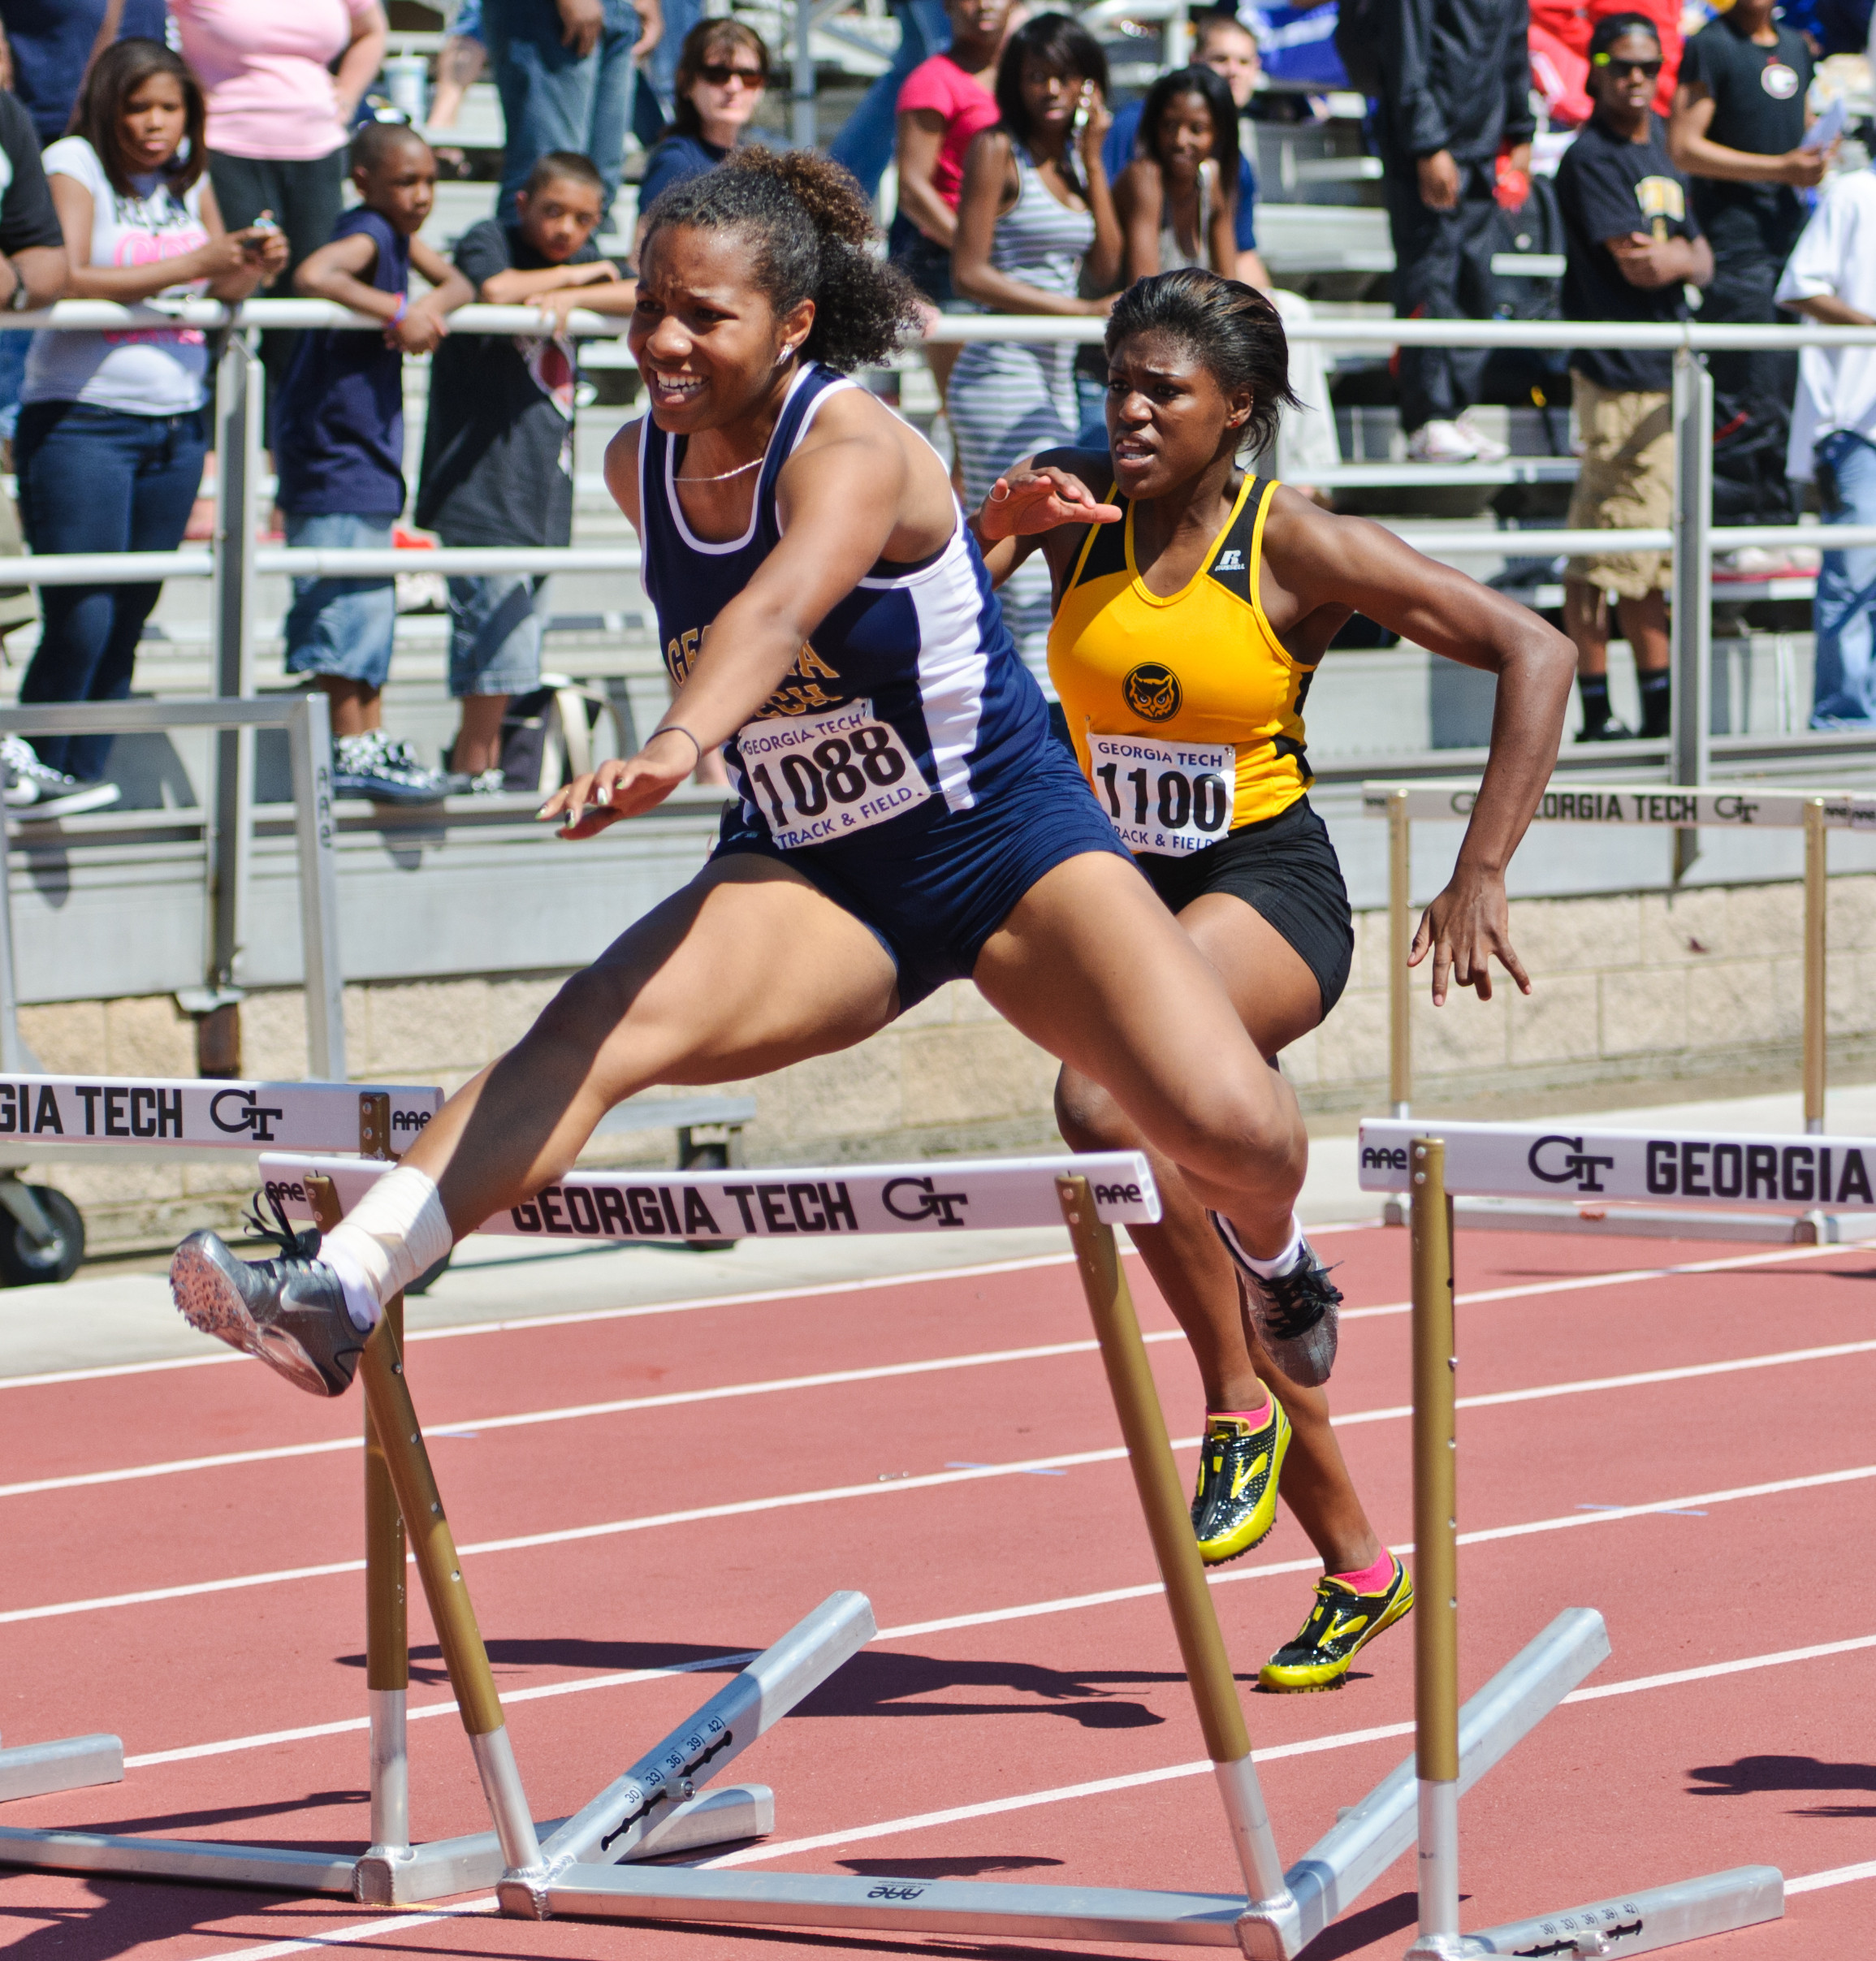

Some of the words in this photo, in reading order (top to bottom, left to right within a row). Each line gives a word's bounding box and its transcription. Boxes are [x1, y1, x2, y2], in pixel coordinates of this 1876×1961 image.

[744, 729, 815, 755] GEORGIA
[815, 715, 863, 736] TECH
[1098, 742, 1172, 763] GEORGIA
[1178, 753, 1222, 767] TECH
[752, 726, 906, 827] 1088
[1097, 762, 1226, 832] 1100
[777, 819, 836, 849] TRACK
[841, 814, 857, 827] &
[860, 788, 912, 819] FIELD
[1542, 793, 1623, 821] ORGIA
[1632, 795, 1697, 822] TECH
[1112, 826, 1148, 845] RACK
[1155, 834, 1165, 847] &
[76, 1086, 183, 1138] TECH
[210, 1089, 283, 1141] GT
[1528, 1135, 1614, 1192] GT
[1646, 1140, 1874, 1203] GEORGIA
[723, 1181, 859, 1233] TECH
[881, 1177, 969, 1227] GT
